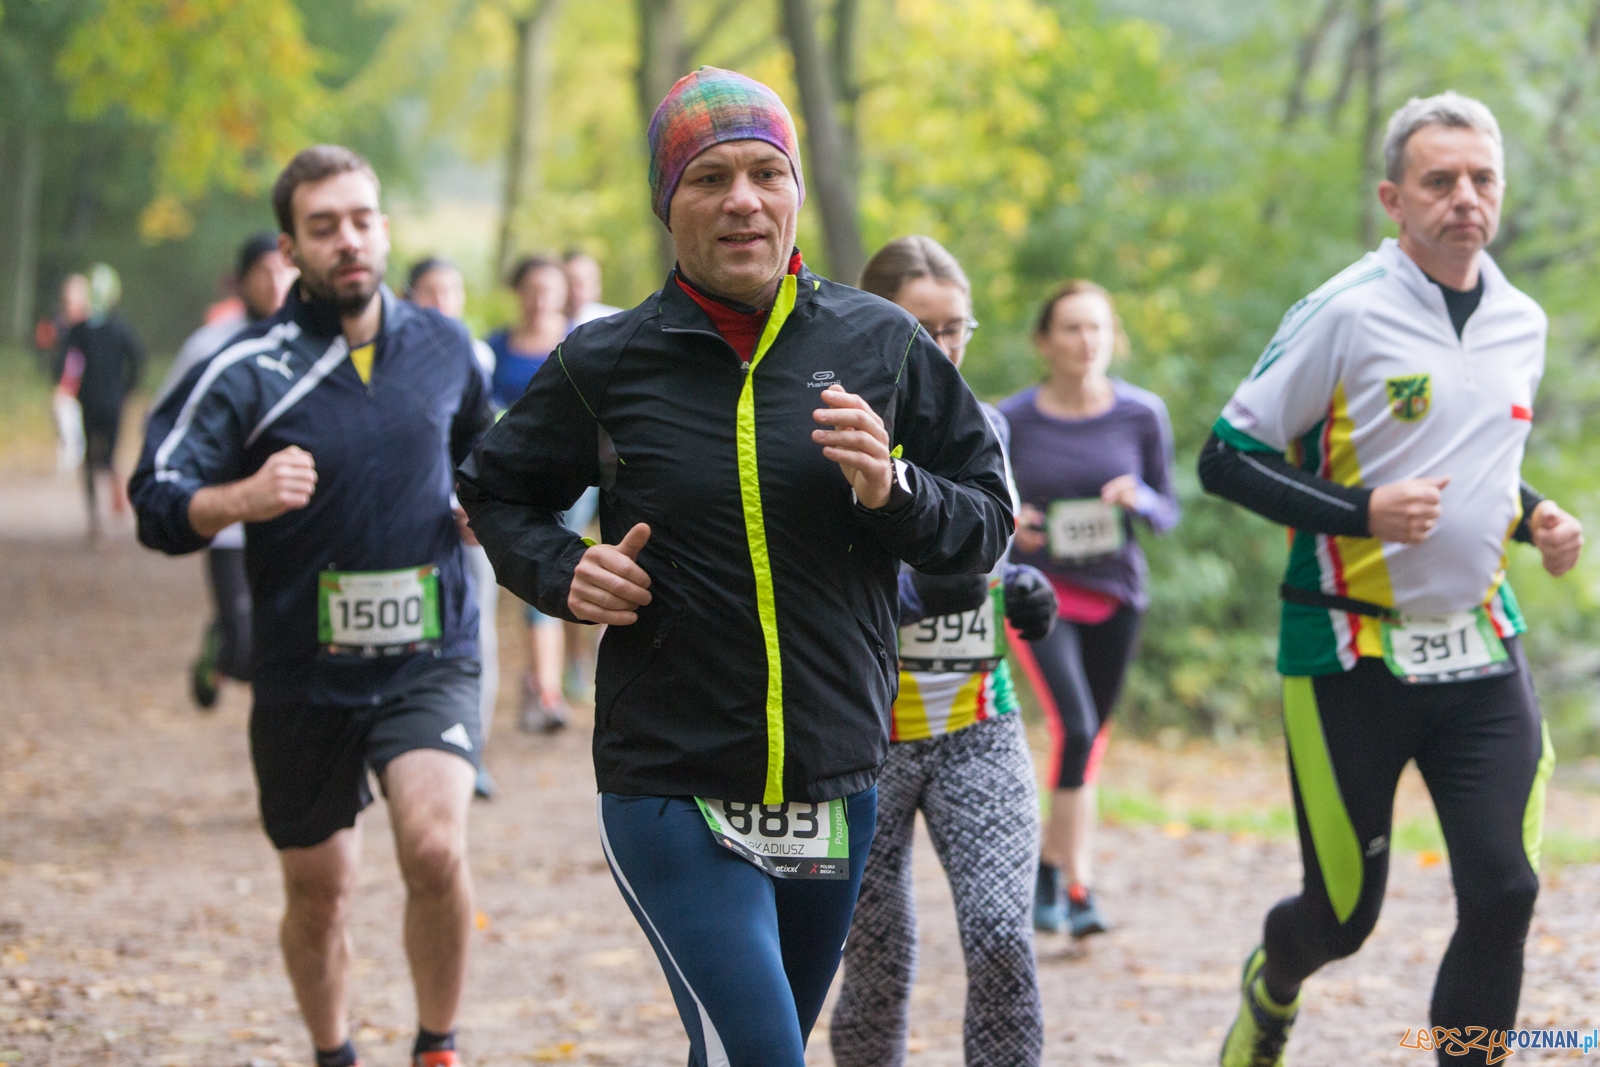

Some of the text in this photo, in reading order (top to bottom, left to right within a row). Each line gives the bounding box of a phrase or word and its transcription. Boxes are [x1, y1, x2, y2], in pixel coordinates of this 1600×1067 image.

[336, 596, 421, 629] 1500
[915, 609, 987, 642] 394
[1411, 627, 1467, 664] 391
[722, 801, 818, 838] 883
[834, 805, 843, 846] Poznań
